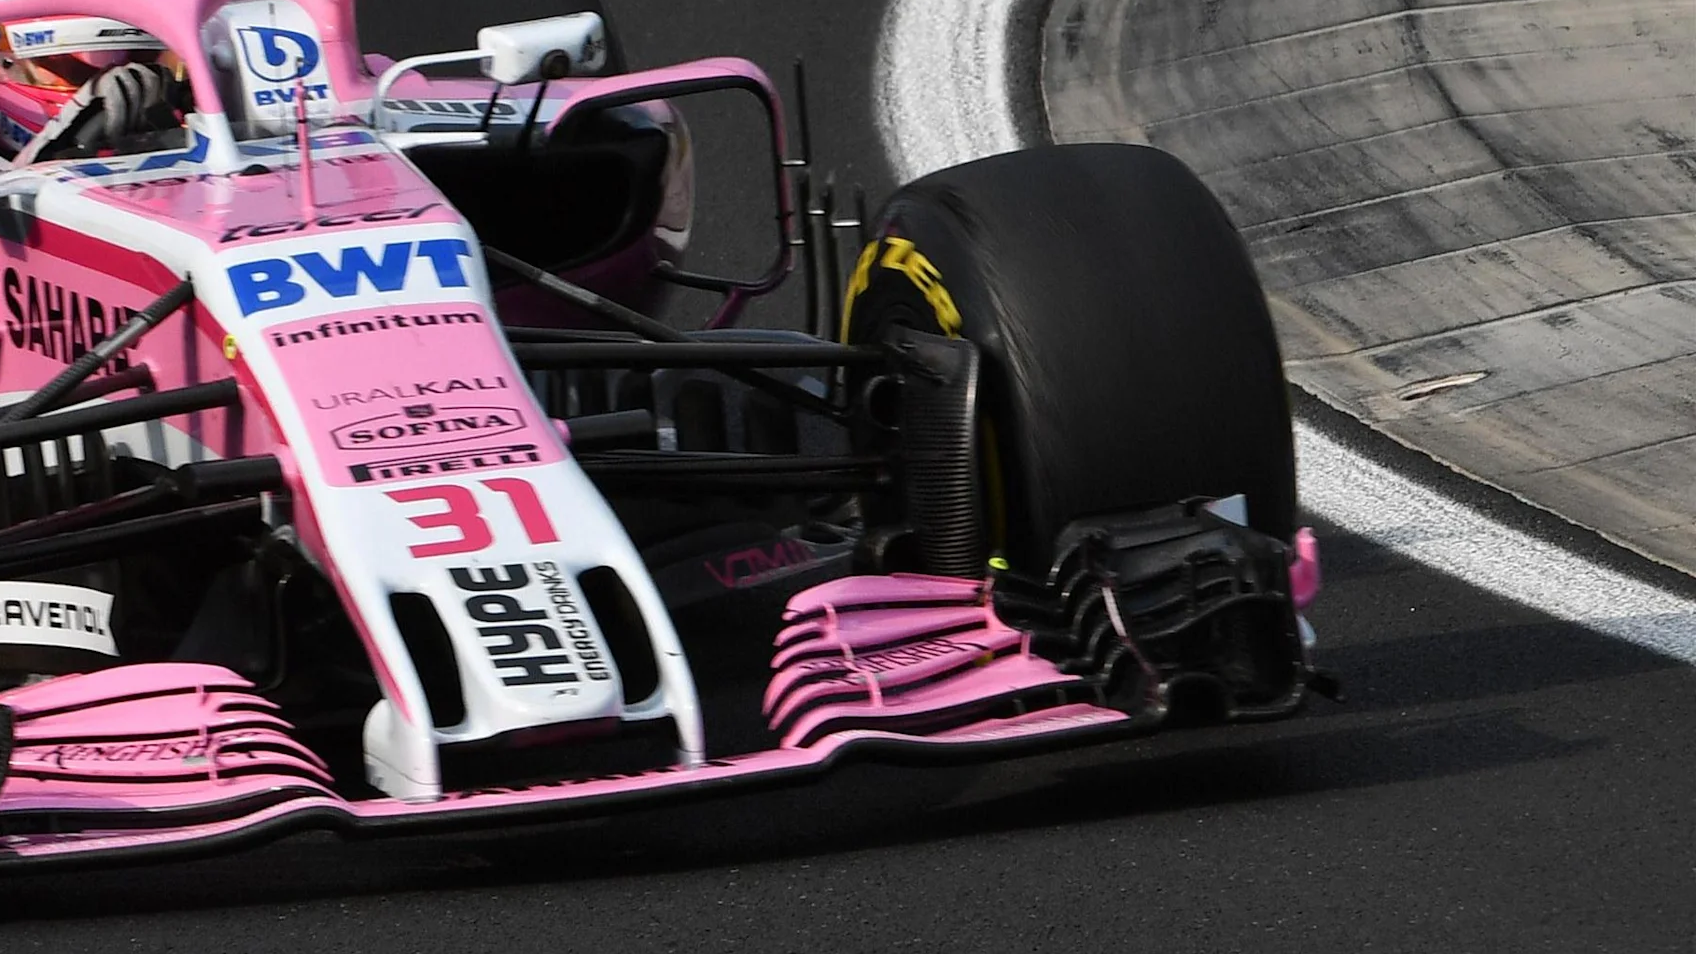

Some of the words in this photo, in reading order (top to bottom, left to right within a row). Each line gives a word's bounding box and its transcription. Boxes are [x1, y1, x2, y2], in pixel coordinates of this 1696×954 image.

[23, 29, 55, 47] BWT
[252, 84, 328, 106] BWT
[226, 238, 474, 318] BWT
[271, 310, 484, 347] infinitum
[311, 376, 509, 410] URALKALI
[348, 414, 513, 444] SOFINA
[348, 444, 542, 483] PIRELLI
[381, 477, 561, 559] 31
[532, 560, 581, 615] DRINKS
[447, 563, 581, 687] HYPE
[560, 618, 612, 682] ENERGY
